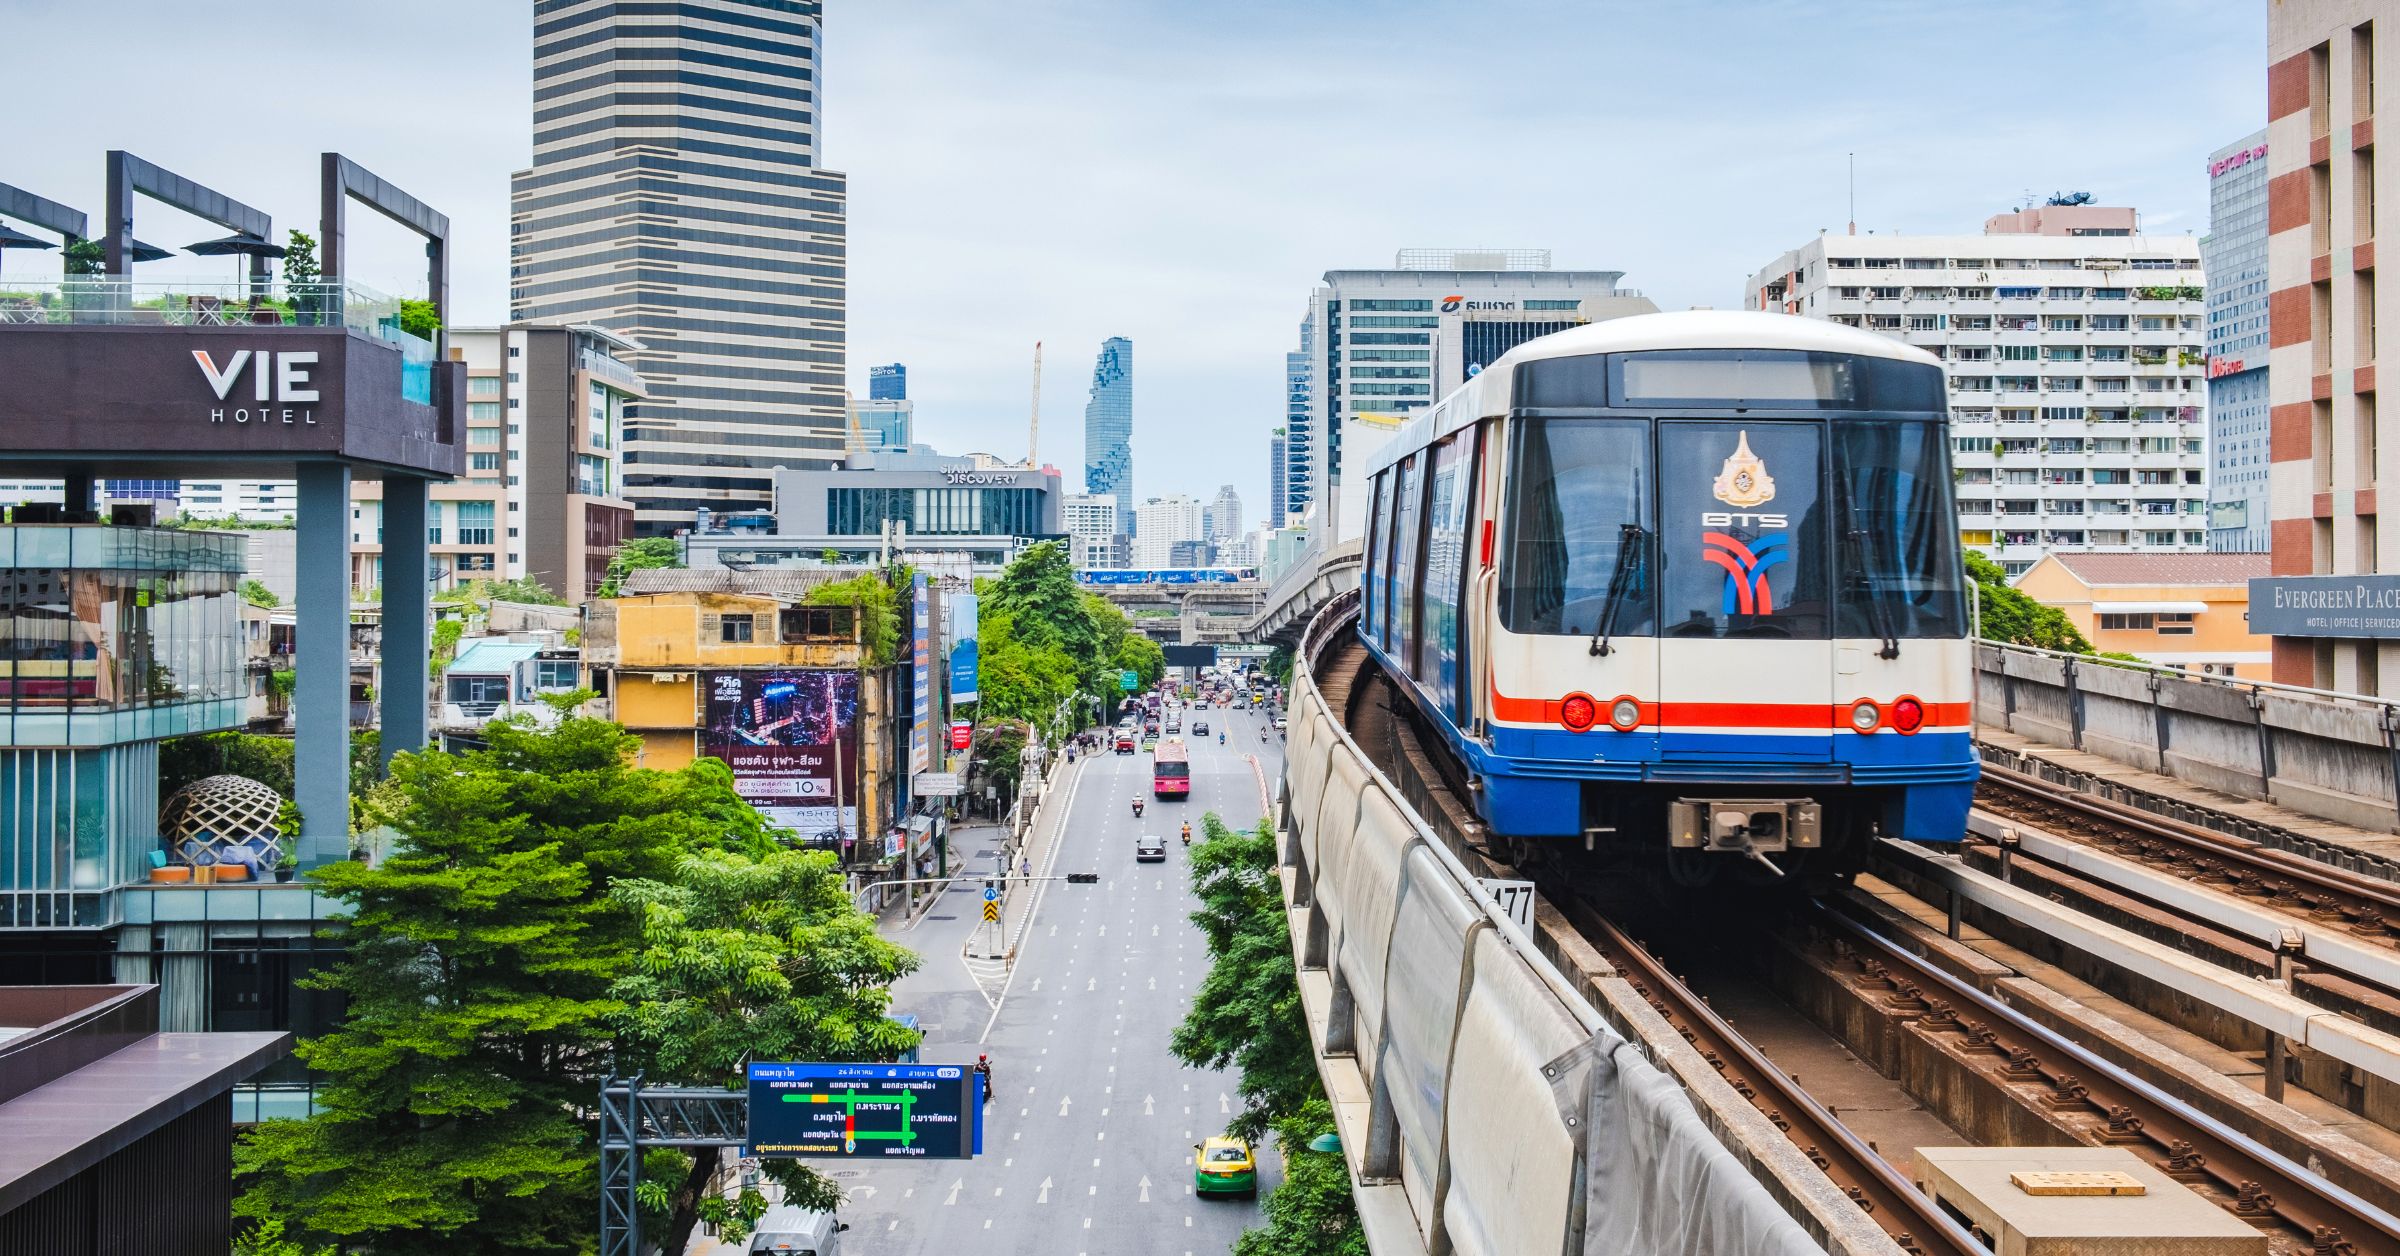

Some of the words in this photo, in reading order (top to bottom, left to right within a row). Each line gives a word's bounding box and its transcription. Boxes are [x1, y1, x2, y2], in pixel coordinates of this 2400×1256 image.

[191, 350, 320, 402] VIE
[211, 408, 316, 424] HOTEL
[940, 464, 971, 474] SIAM
[947, 474, 1017, 484] DISCOVERY
[1702, 512, 1788, 528] BTS
[2307, 617, 2328, 628] HOTEL
[2335, 617, 2359, 628] OFFICE
[733, 754, 769, 766] แอชตัน
[772, 754, 822, 769] จุฬา-สีลม
[795, 781, 814, 793] 10
[816, 784, 825, 793] %
[754, 1066, 795, 1078] ถนนพญาไท
[813, 1112, 846, 1123] ถ.พญาไท
